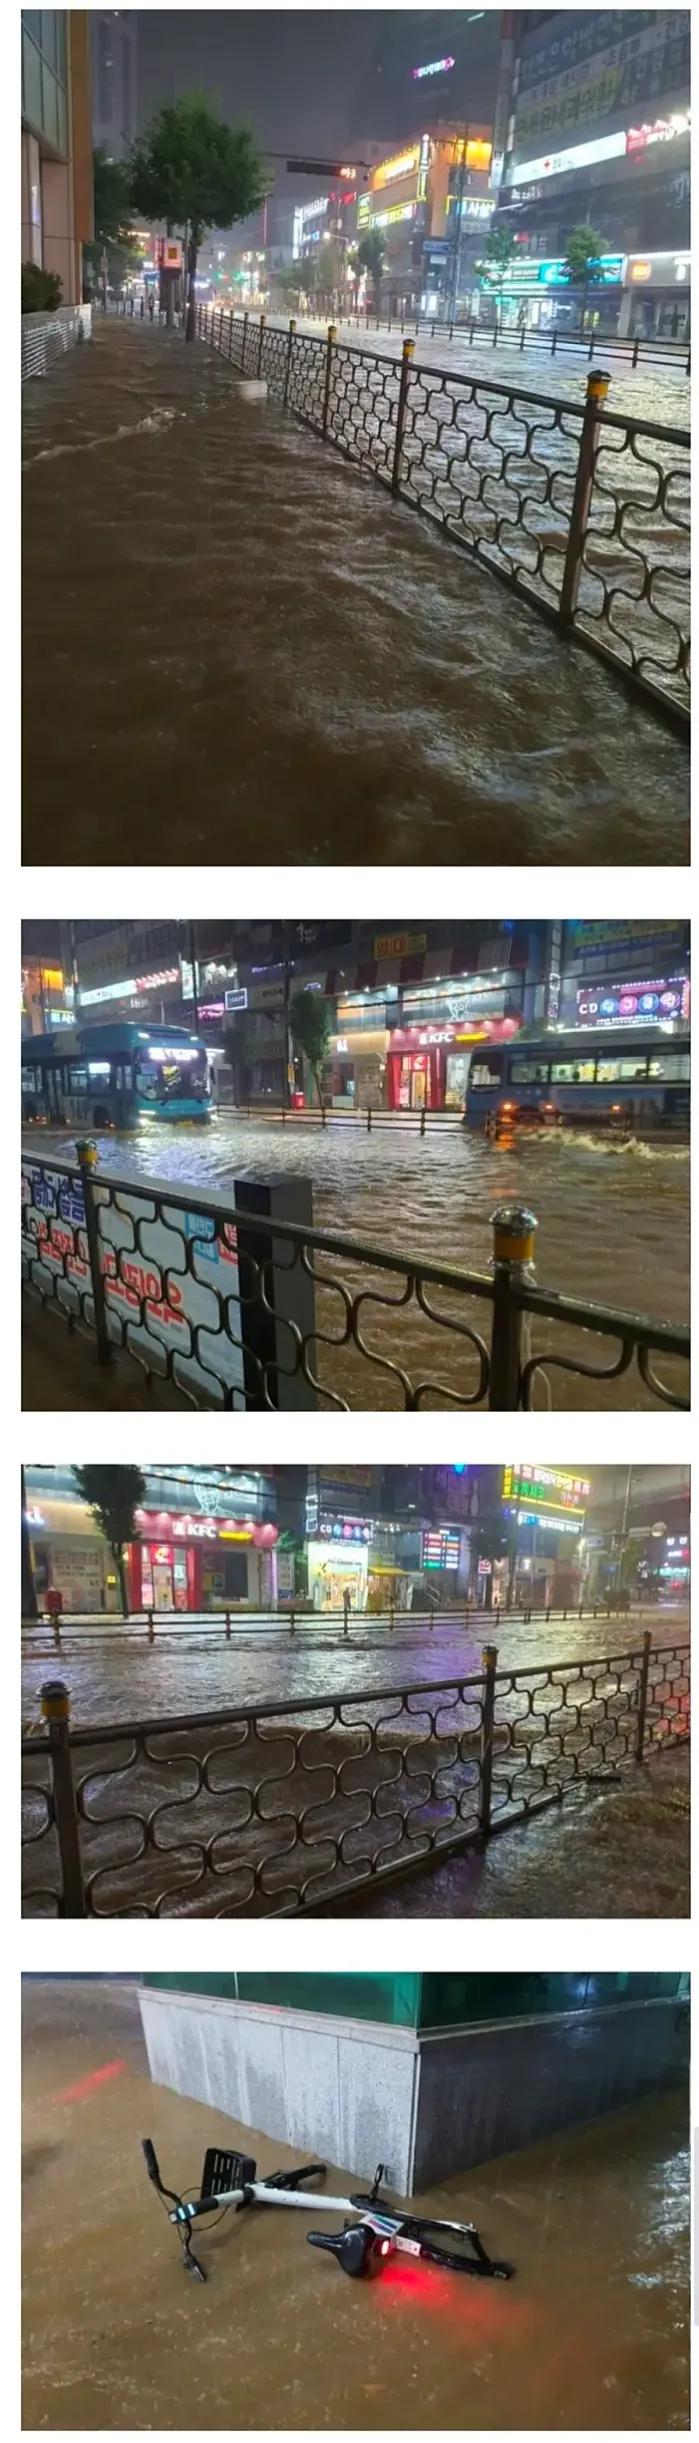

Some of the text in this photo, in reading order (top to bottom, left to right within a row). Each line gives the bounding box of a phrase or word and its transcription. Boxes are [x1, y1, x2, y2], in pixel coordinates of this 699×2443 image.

[579, 1003, 598, 1014] CD
[429, 1033, 454, 1043] KFC
[187, 1523, 216, 1537] KFC
